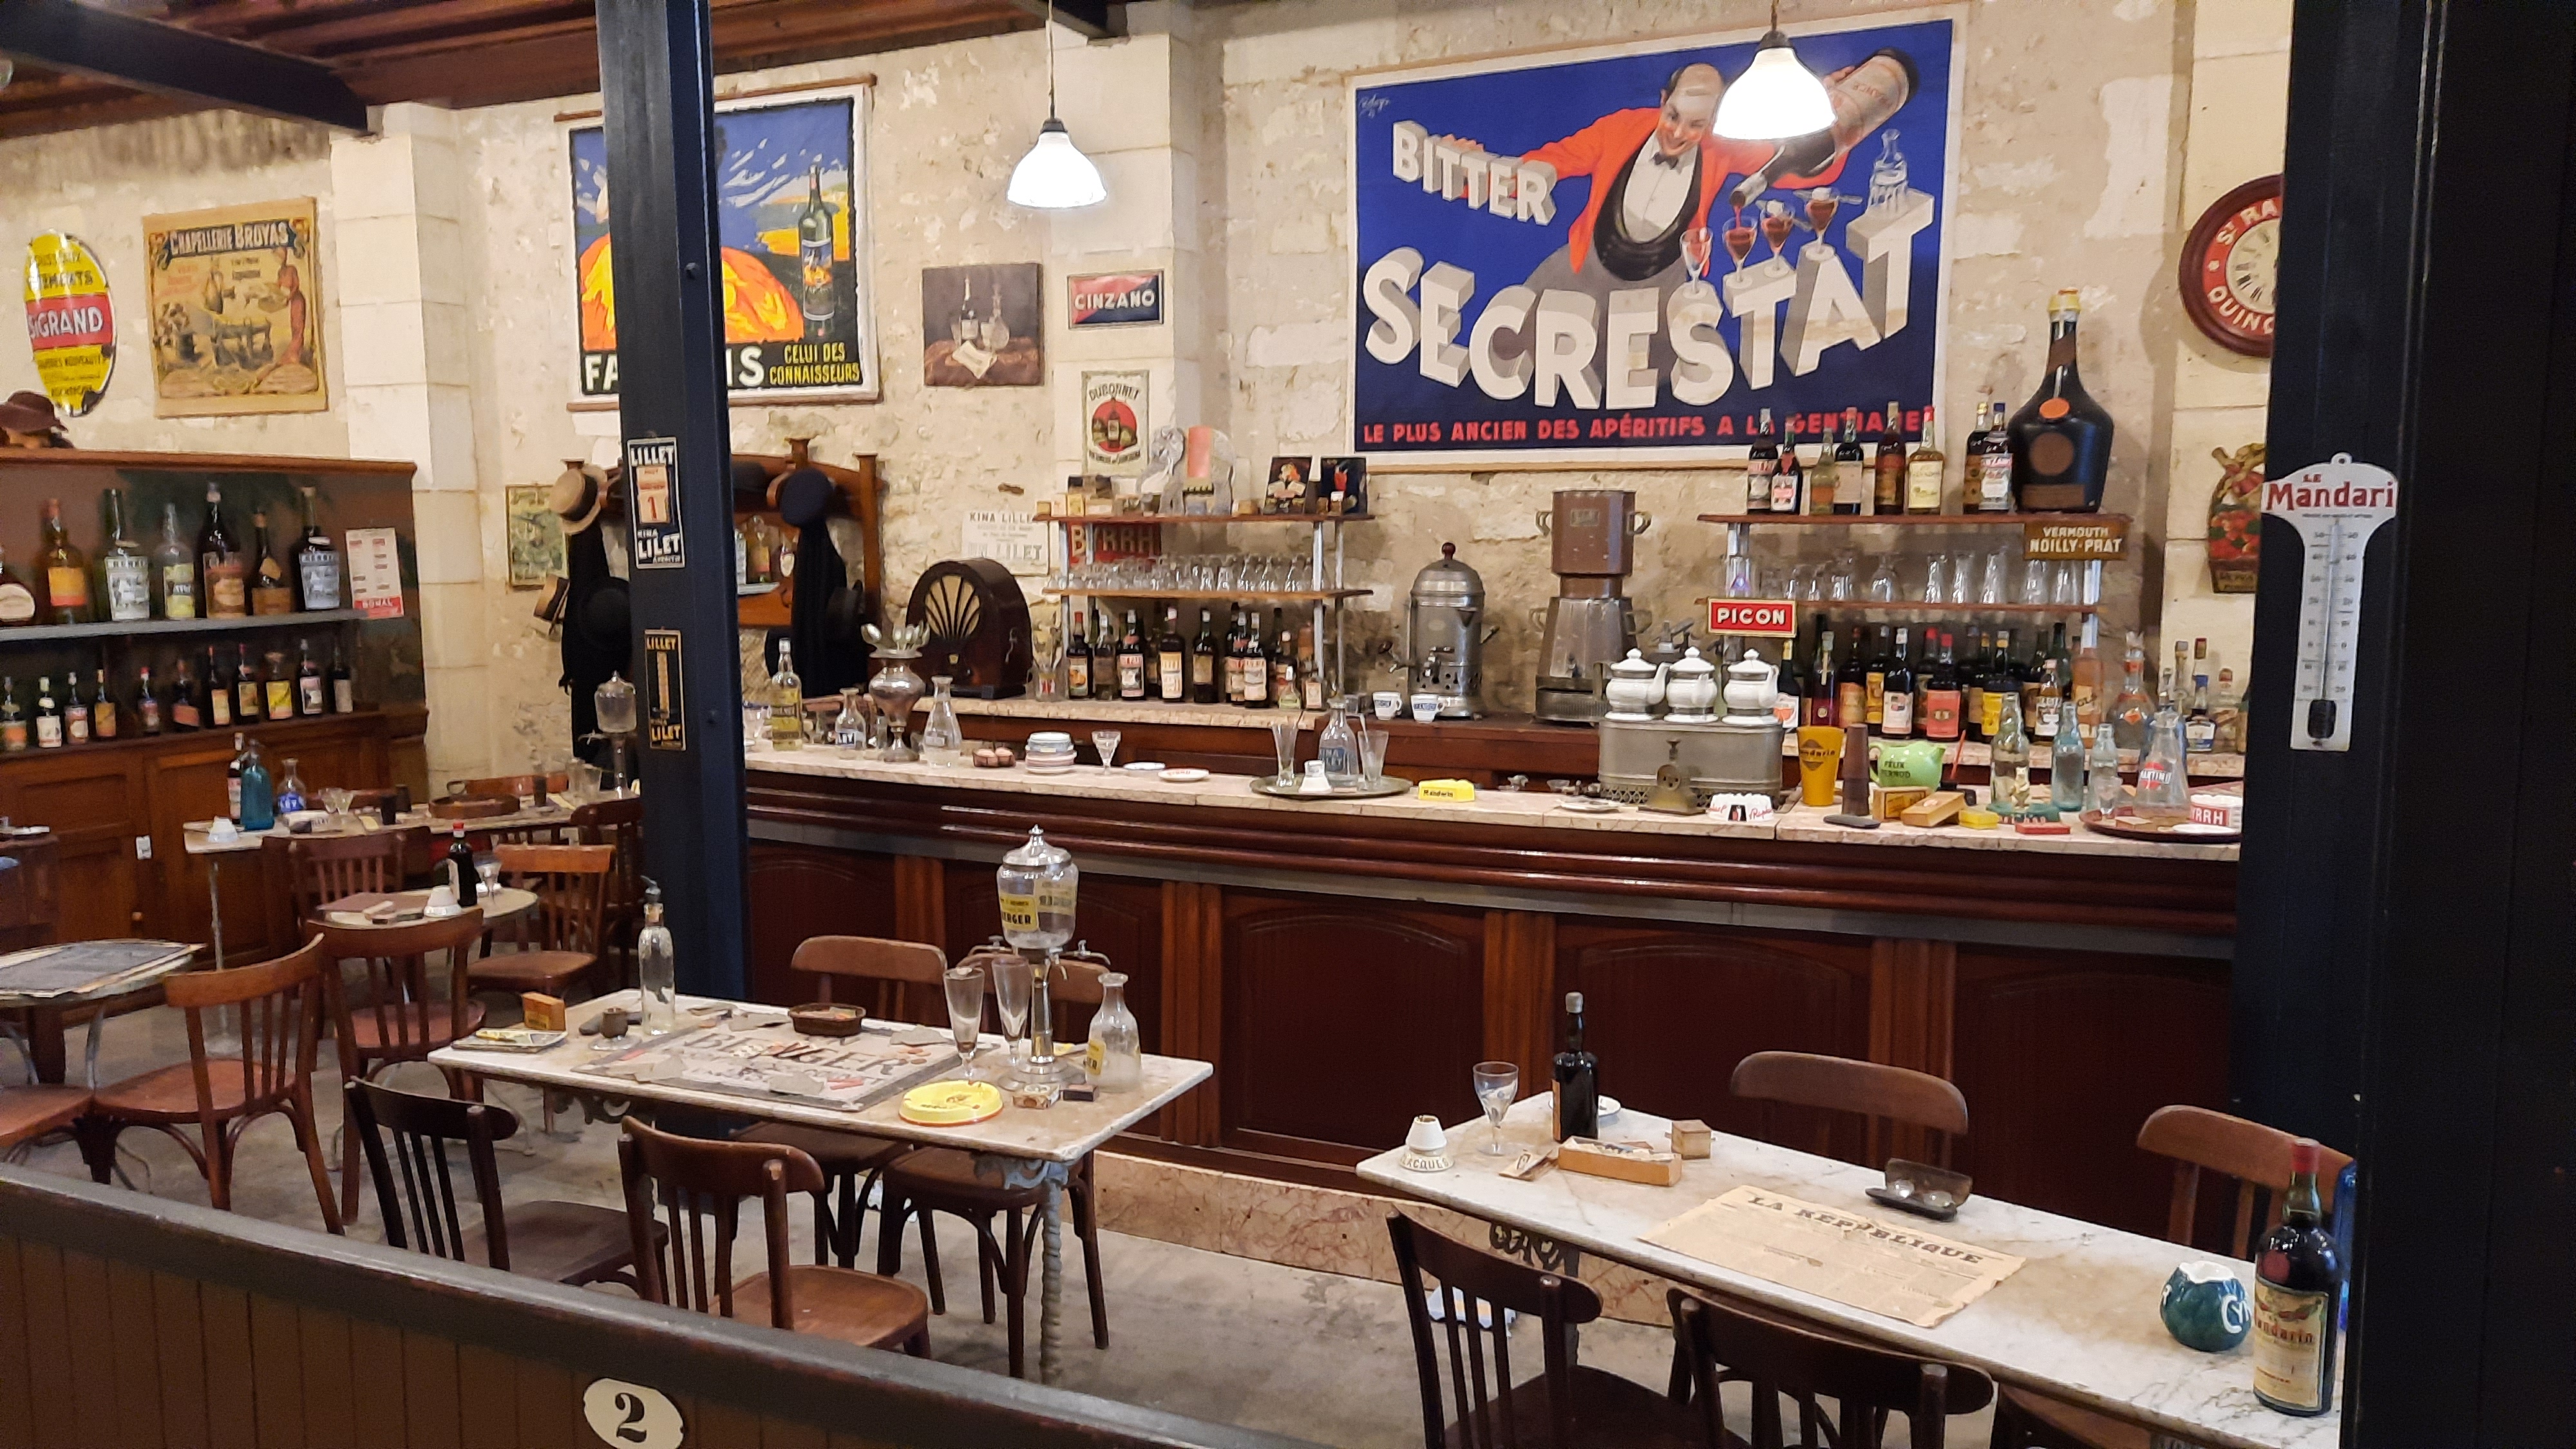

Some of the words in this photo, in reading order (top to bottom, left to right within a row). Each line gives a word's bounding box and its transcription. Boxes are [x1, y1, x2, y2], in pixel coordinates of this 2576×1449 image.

[1393, 121, 1558, 226] BITTER
[1074, 289, 1155, 312] CINZANO
[1363, 187, 1935, 410] SECRESTAT
[784, 345, 819, 365] CELUI
[822, 342, 846, 362] DES
[770, 362, 860, 386] CONNAISSEURS
[1363, 424, 1383, 442] LE
[1393, 422, 1441, 441] PLUS
[1452, 421, 1527, 440] ANCIEN
[1538, 419, 1580, 440] DES
[1589, 413, 1705, 439] APÉRITIFS
[1718, 415, 1734, 435] A
[630, 446, 675, 467] LILLET
[2266, 481, 2393, 511] Mandari
[970, 512, 996, 522] KINA
[1001, 513, 1030, 523] LILL
[1071, 524, 1157, 557] BRRH
[2043, 526, 2109, 538] VERMOUTH
[1717, 607, 1785, 625] PICON
[1748, 1197, 1783, 1211] LA
[615, 1392, 647, 1443] 2
